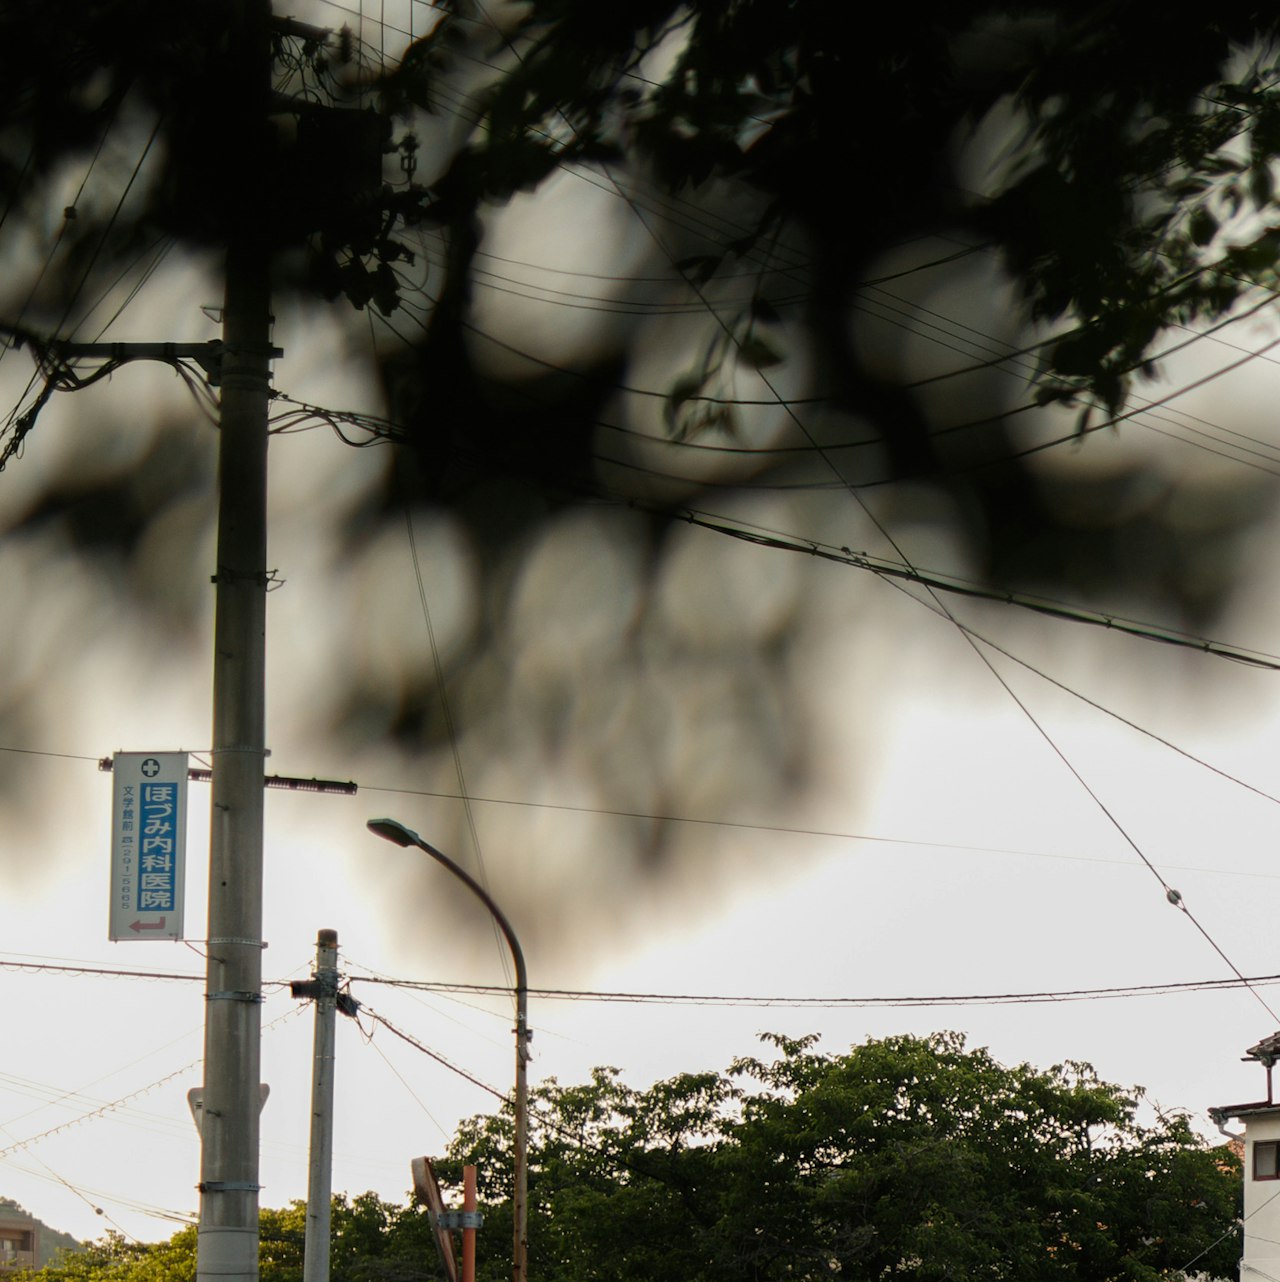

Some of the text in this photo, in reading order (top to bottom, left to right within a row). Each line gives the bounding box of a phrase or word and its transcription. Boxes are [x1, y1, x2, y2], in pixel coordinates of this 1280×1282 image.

[122, 786, 134, 831] 文学館前
[141, 786, 172, 908] ほづみ内科医院
